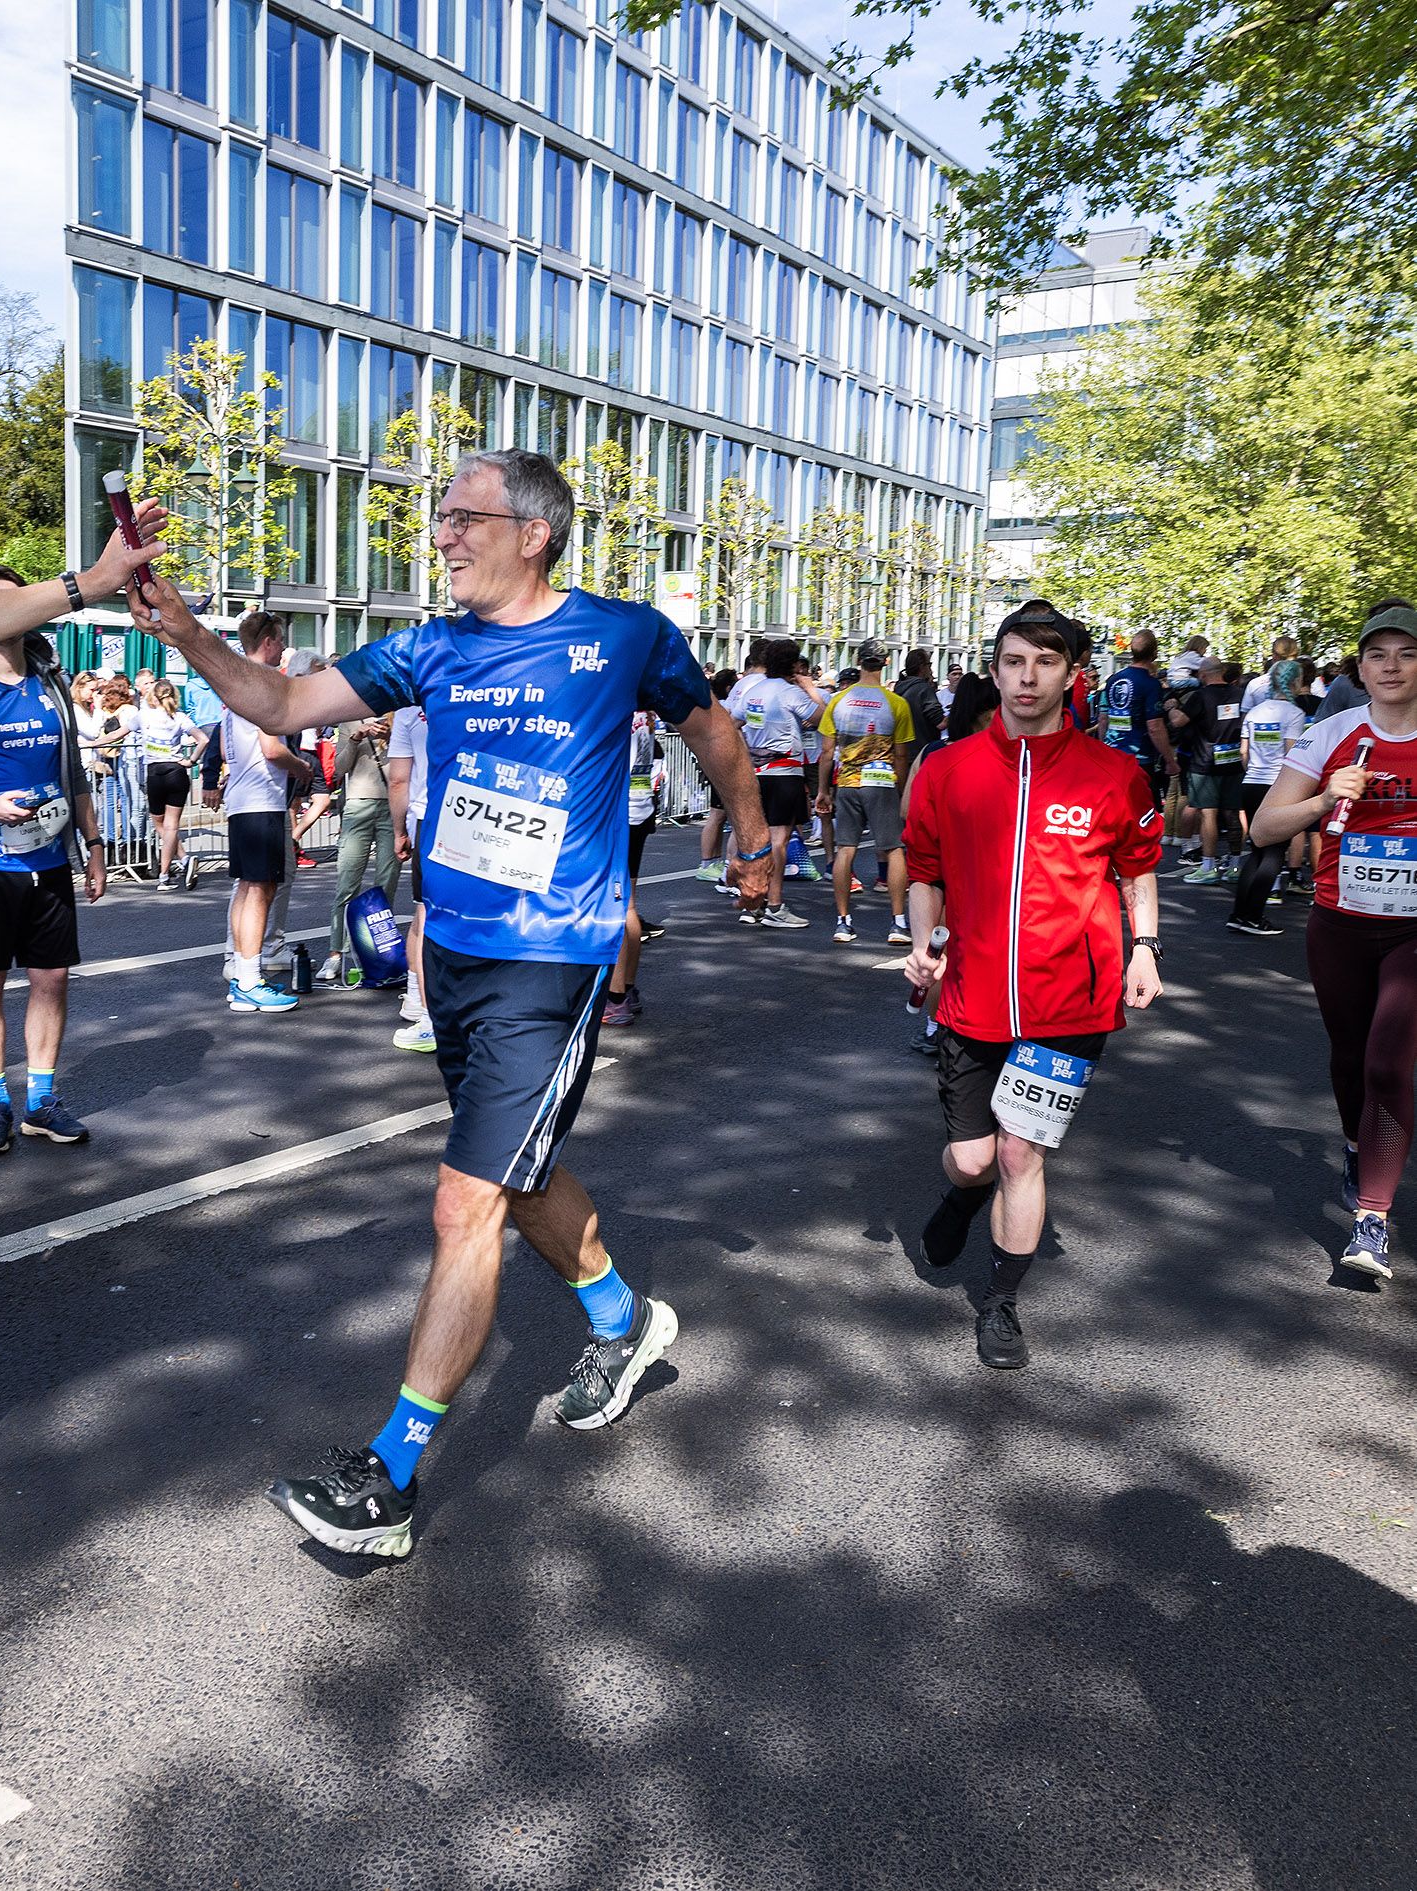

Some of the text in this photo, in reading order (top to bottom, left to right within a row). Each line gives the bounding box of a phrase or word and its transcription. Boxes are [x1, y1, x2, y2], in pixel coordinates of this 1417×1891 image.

[567, 641, 601, 659] uni
[570, 657, 609, 674] per
[449, 683, 545, 707] Energy in
[29, 719, 43, 730] in
[465, 714, 575, 740] every step.
[2, 737, 35, 749] every
[458, 763, 482, 779] per
[495, 762, 520, 778] uni
[495, 774, 525, 791] per
[446, 796, 455, 808] J
[454, 796, 547, 840] S7422
[1045, 803, 1092, 828] GO!
[472, 830, 511, 848] UNIPER
[1347, 835, 1366, 846] uni
[1383, 838, 1404, 849] uni
[1350, 844, 1373, 853] per
[1385, 847, 1410, 857] per
[1342, 866, 1350, 875] E
[1017, 1044, 1036, 1057] uni
[1015, 1053, 1039, 1067] per
[1051, 1056, 1073, 1070] uni
[1051, 1066, 1076, 1079] per
[406, 1417, 434, 1435] uni
